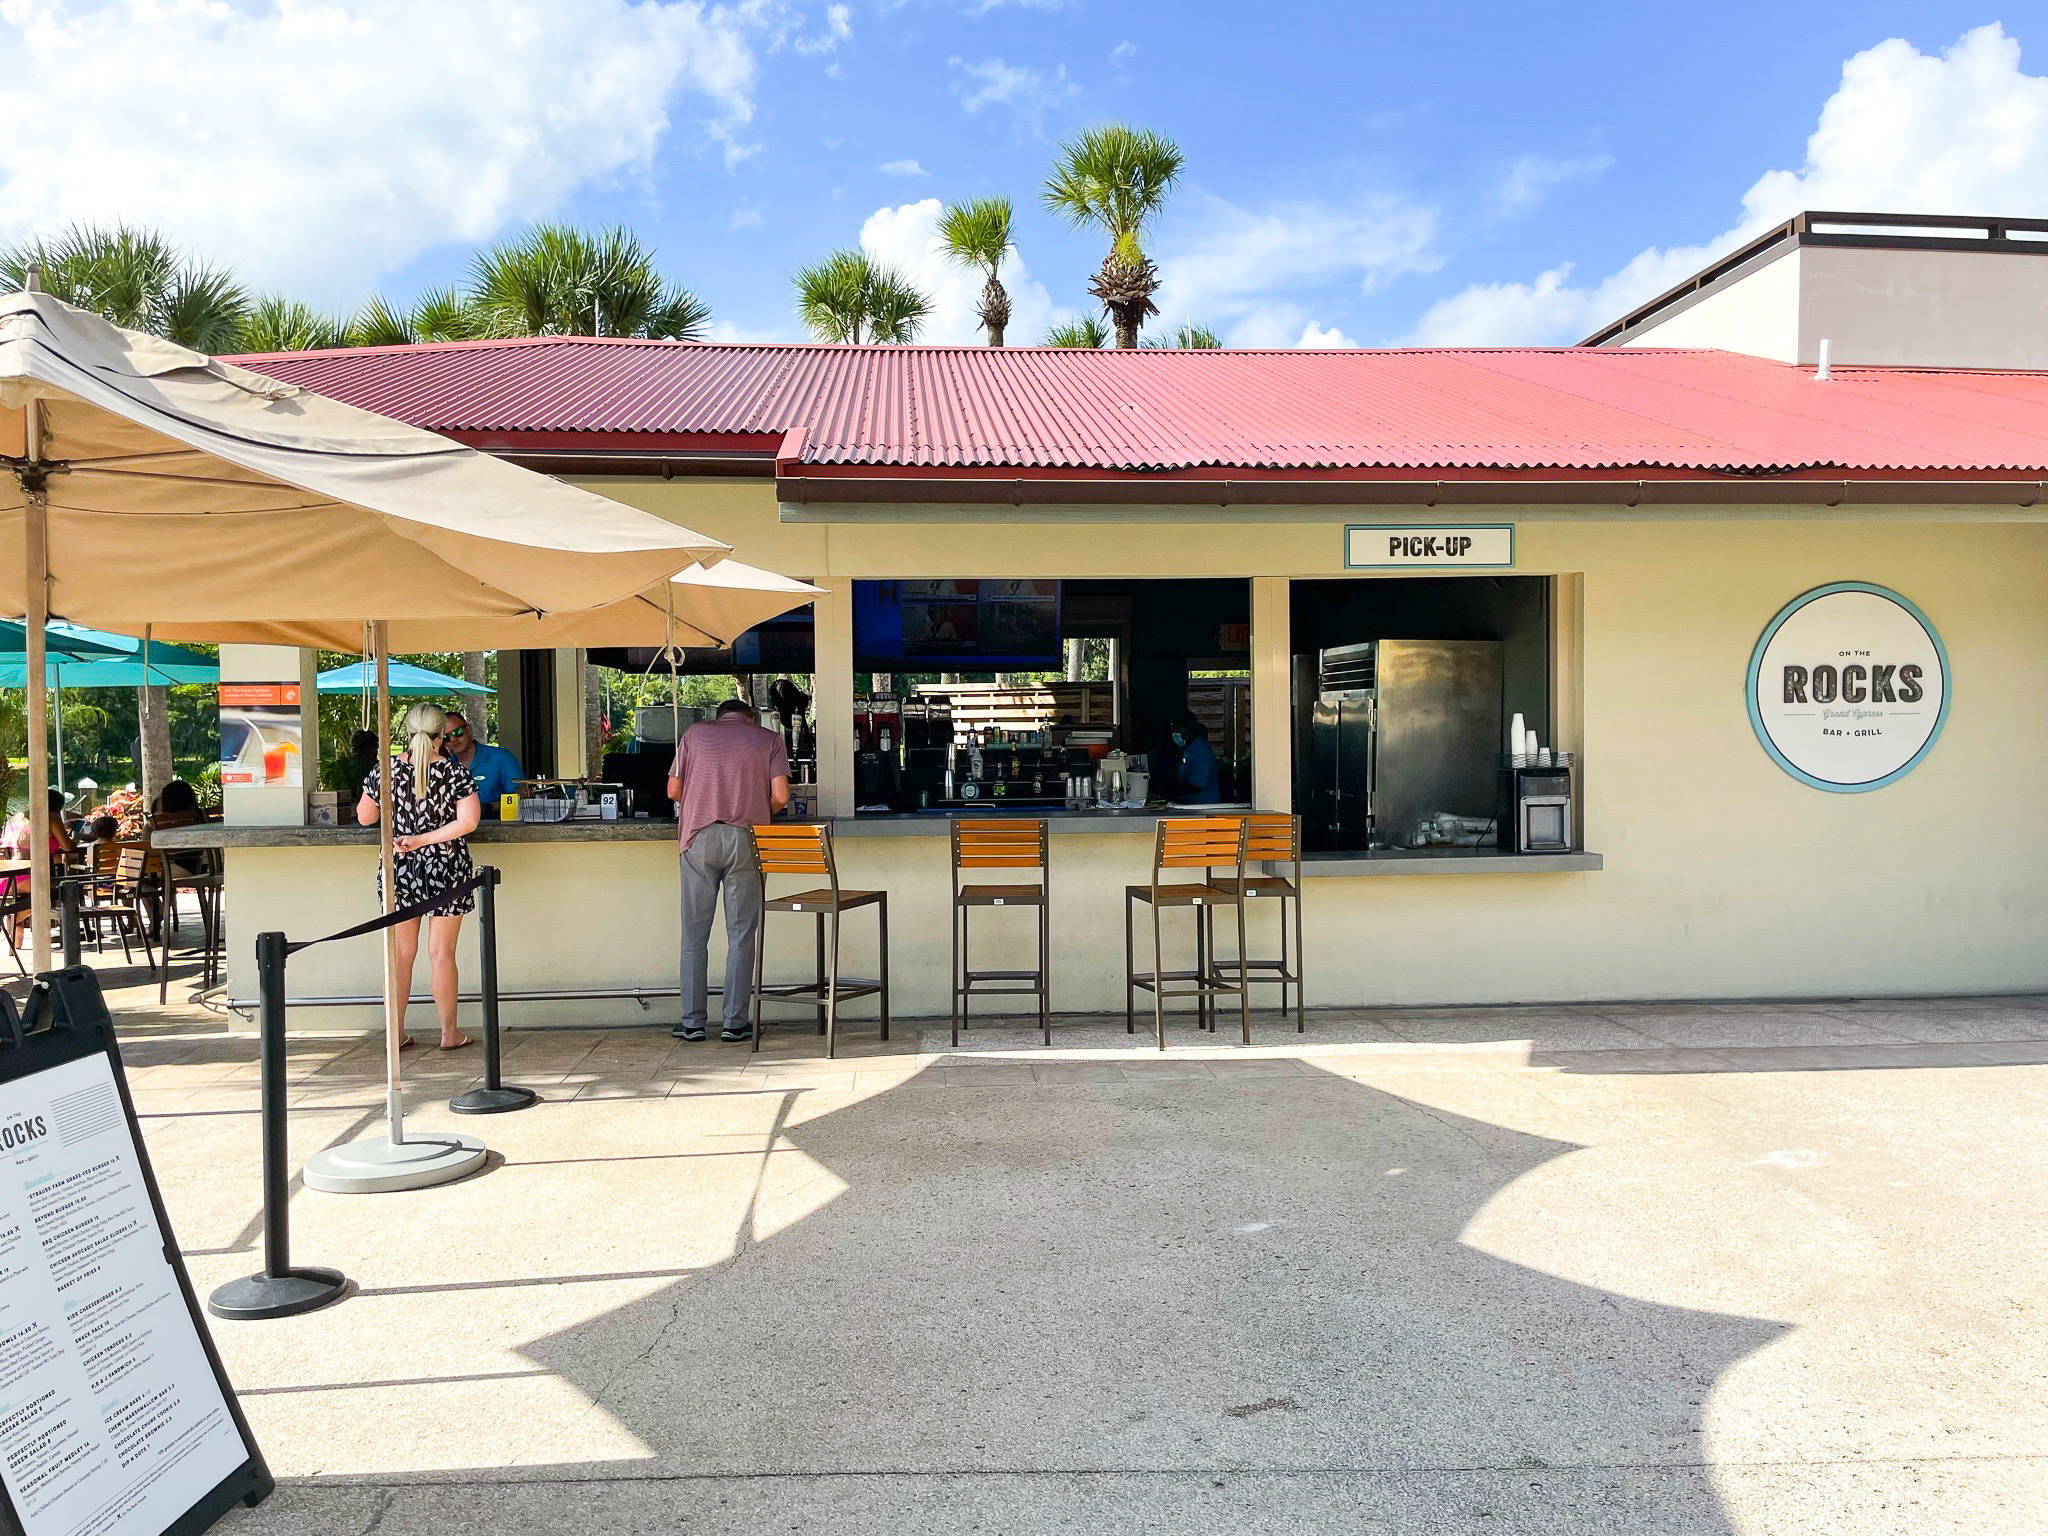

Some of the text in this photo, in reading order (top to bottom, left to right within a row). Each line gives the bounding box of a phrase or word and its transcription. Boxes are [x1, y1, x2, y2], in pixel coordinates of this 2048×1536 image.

[1389, 536, 1472, 557] PICK-UP
[1783, 664, 1924, 703] ROCKS
[1822, 708, 1884, 720] Grand Cypress
[1822, 728, 1883, 737] BAR GRILL
[506, 796, 513, 804] 8
[35, 1211, 54, 1223] BEYOND
[55, 1202, 74, 1213] BURGER
[53, 1228, 74, 1240] CHICKEN
[75, 1218, 93, 1230] BURGER
[50, 1255, 71, 1269] CHICKEN
[72, 1244, 93, 1257] AVOCADO
[95, 1236, 109, 1246] SALAD
[110, 1226, 127, 1238] SLIDERS
[57, 1279, 75, 1292] BASKET
[84, 1268, 97, 1278] FRIES
[67, 1312, 78, 1320] KIDS
[79, 1291, 114, 1313] CHEESEBURGER
[75, 1332, 90, 1343] SNACK
[91, 1324, 103, 1333] PACK
[83, 1351, 103, 1366] CHICKEN
[104, 1338, 124, 1352] TENDERS
[109, 1360, 132, 1378] SANDWICH
[26, 1390, 55, 1410] PORTIONED
[108, 1420, 124, 1433] CHEWY
[125, 1396, 158, 1421] MARSHMALLOW
[159, 1389, 167, 1397] BAR
[113, 1405, 128, 1417] CREAM
[129, 1396, 141, 1406] BARS
[21, 1409, 38, 1423] SALAD
[115, 1428, 140, 1449] CHOCOLATE
[141, 1416, 156, 1429] CHUNK
[157, 1404, 173, 1418] COOKIE
[7, 1420, 66, 1462] PERFECTLY PORTIONED
[118, 1437, 144, 1458] CHOCOLATE
[145, 1422, 164, 1438] BROWNIE
[10, 1454, 28, 1469] GREEN
[29, 1442, 46, 1456] SALAD
[135, 1447, 147, 1458] DOTS
[20, 1472, 48, 1493] SEASONAL
[48, 1460, 63, 1473] FRUIT
[64, 1446, 83, 1462] MEDLEY
